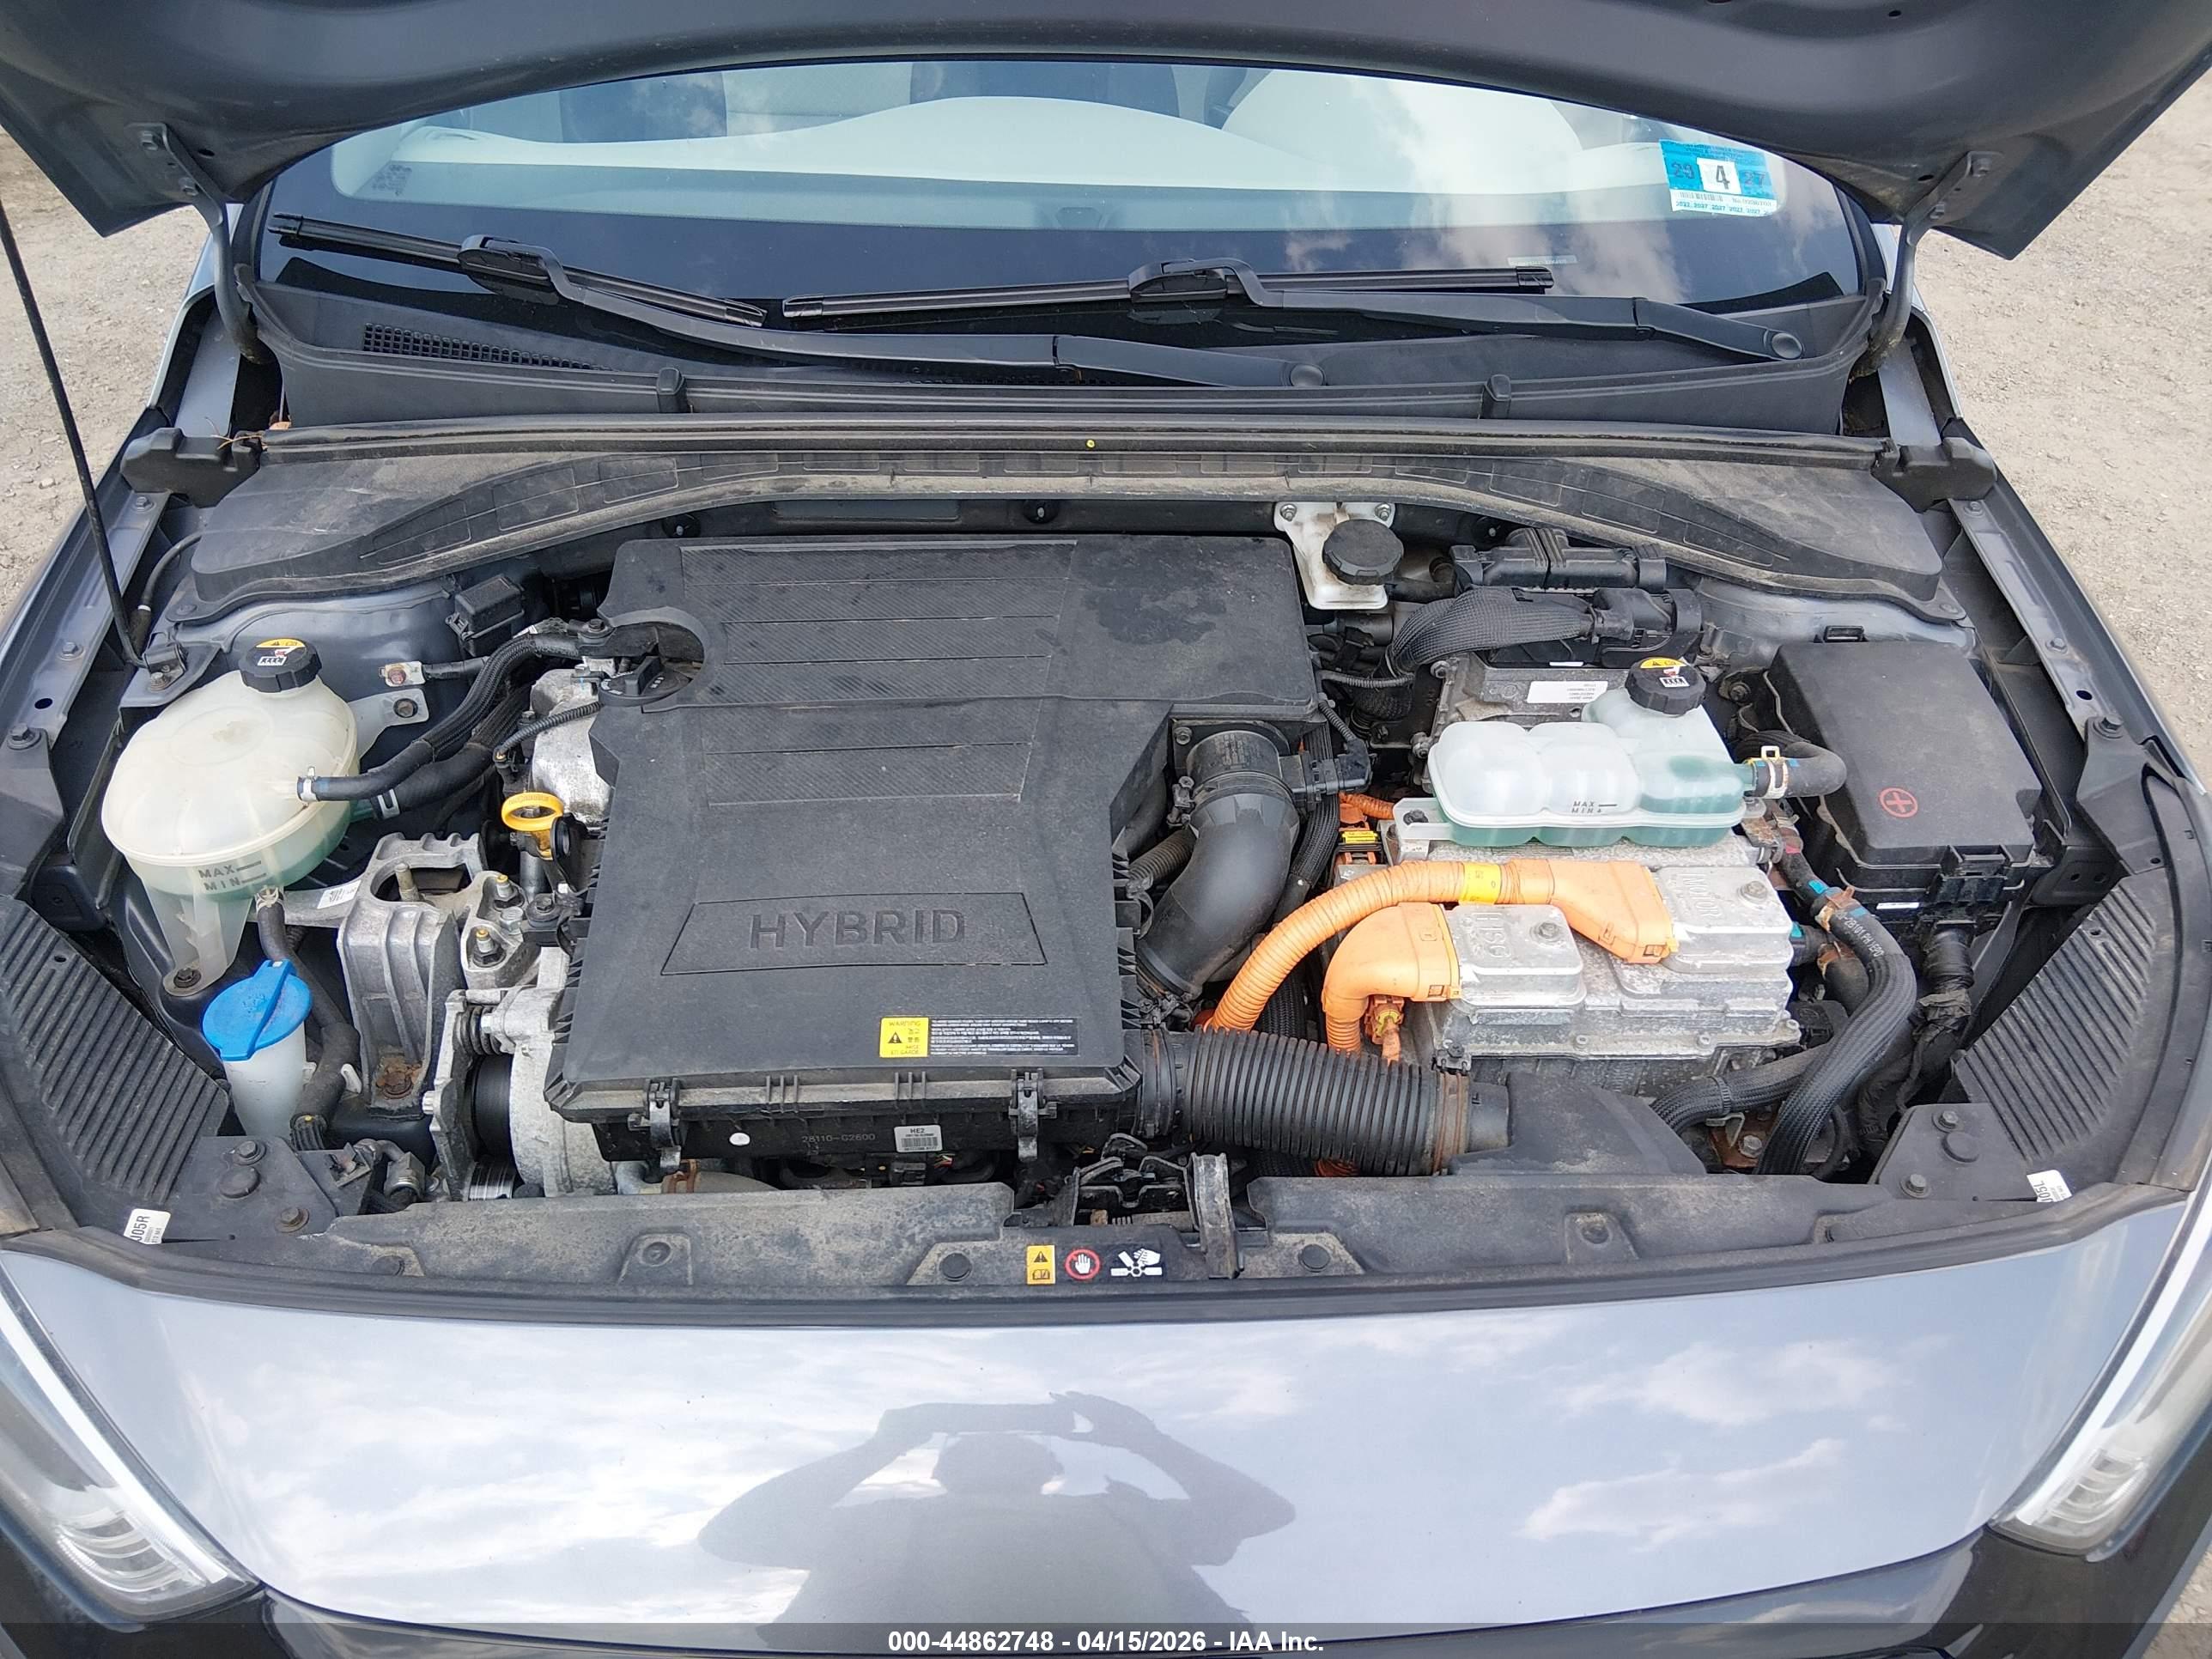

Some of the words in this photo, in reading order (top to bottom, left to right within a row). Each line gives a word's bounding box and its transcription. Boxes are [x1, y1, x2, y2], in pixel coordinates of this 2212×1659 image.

[1716, 165, 1730, 190] 4
[198, 865, 235, 878] MAX
[204, 877, 240, 890] MIN
[750, 908, 965, 949] HYBRID
[130, 1215, 150, 1242] J05R
